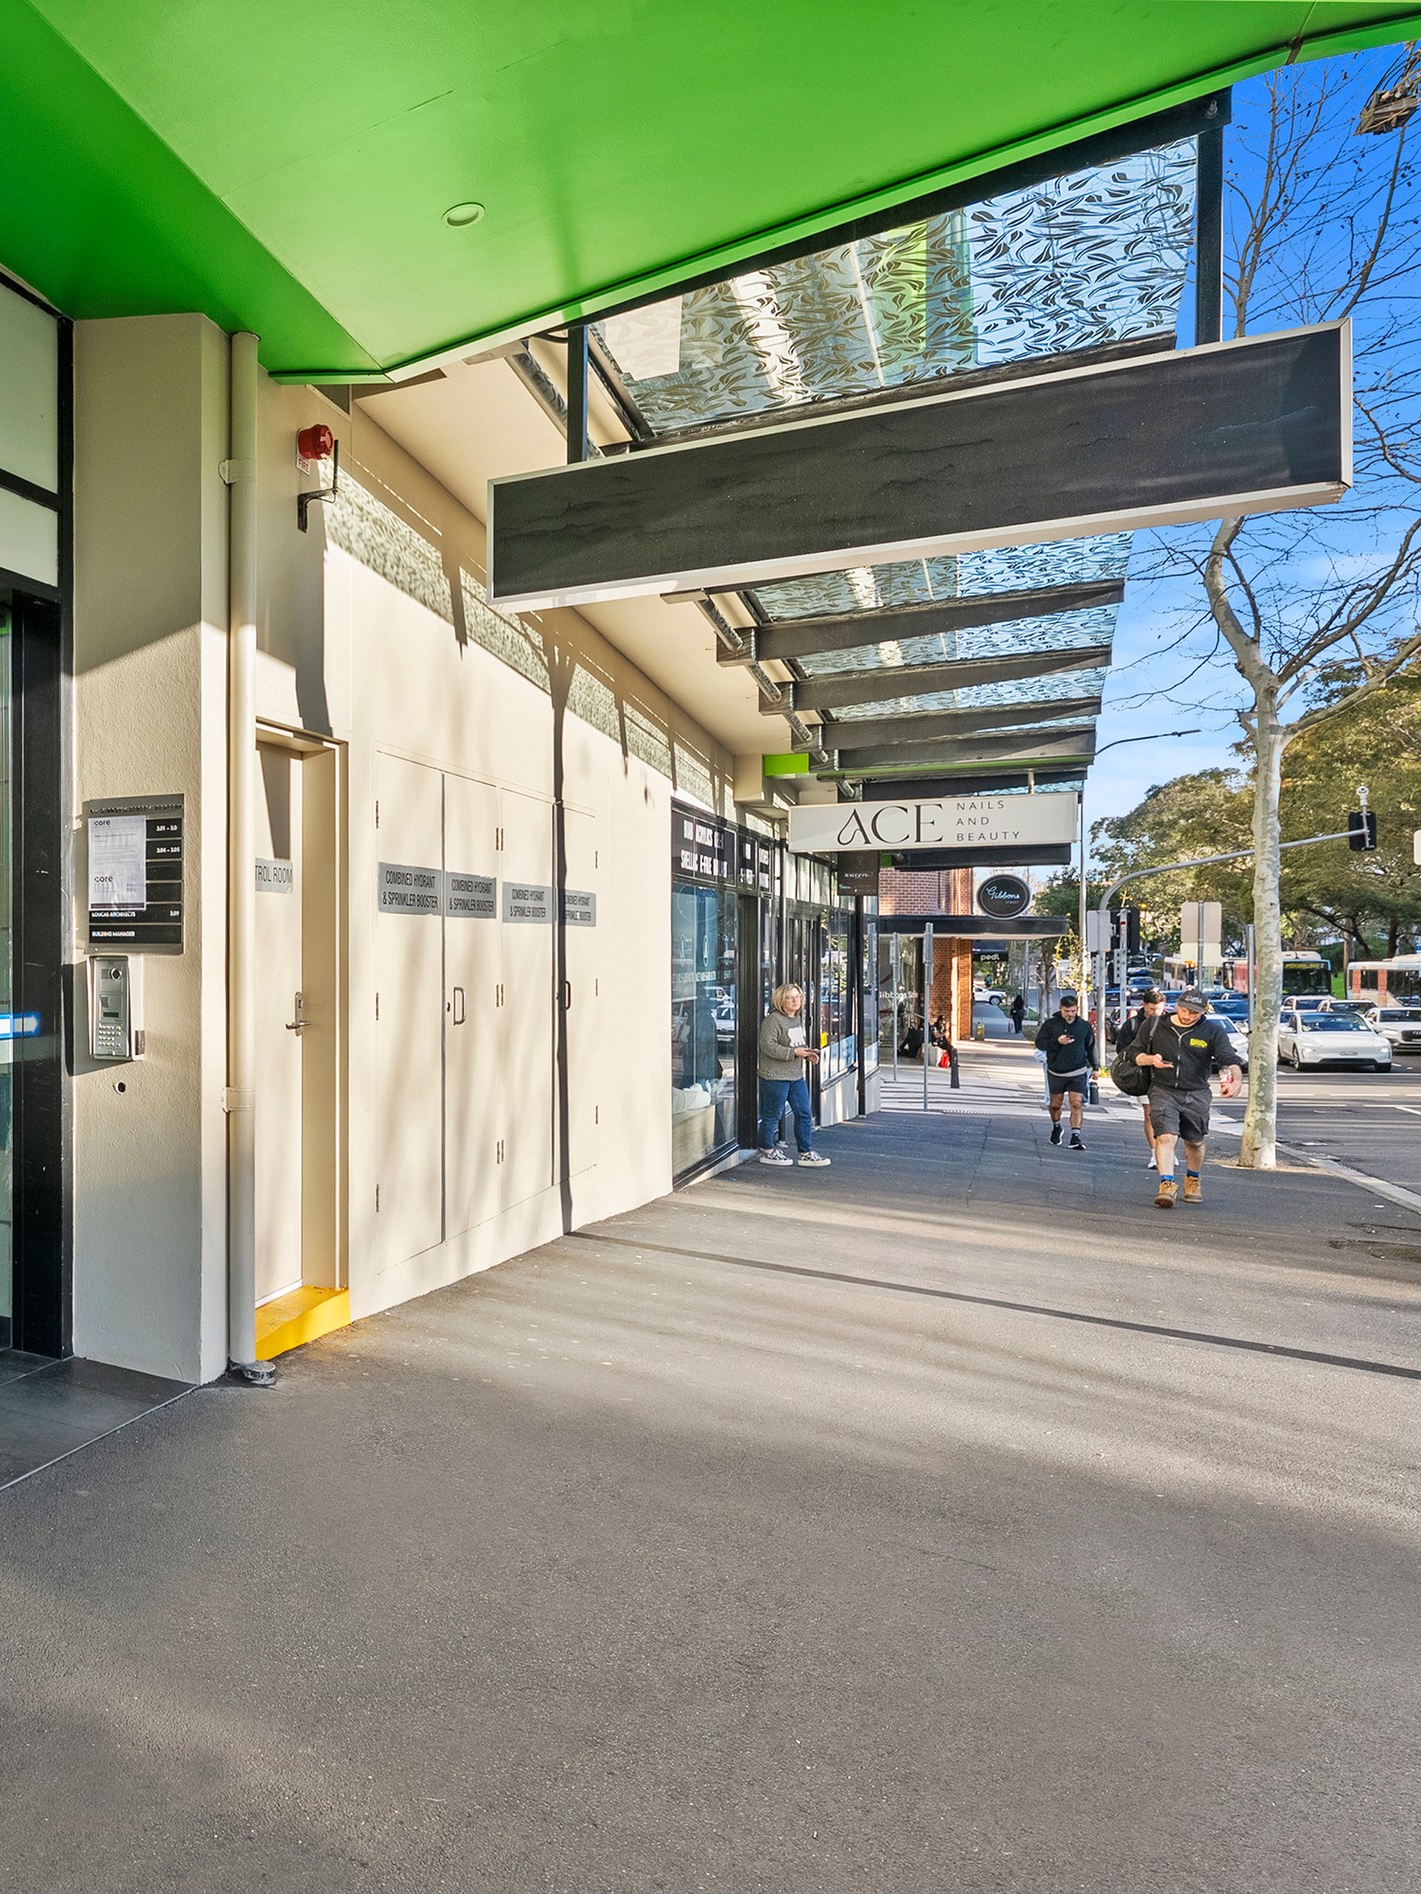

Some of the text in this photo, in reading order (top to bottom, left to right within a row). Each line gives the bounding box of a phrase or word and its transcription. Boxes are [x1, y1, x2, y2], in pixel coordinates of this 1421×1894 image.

[956, 800, 1005, 811] NAILS
[837, 803, 944, 846] ACE
[956, 816, 990, 826] AND
[956, 831, 1021, 842] BEAUTY
[273, 867, 293, 883] ROOM
[386, 870, 436, 889] COMBINED HYDRANT
[451, 879, 492, 895] COMBINED HYDRANT
[986, 886, 1020, 899] Gibbons
[388, 891, 416, 907] SPRINKLER
[417, 894, 438, 909] BOOSTER
